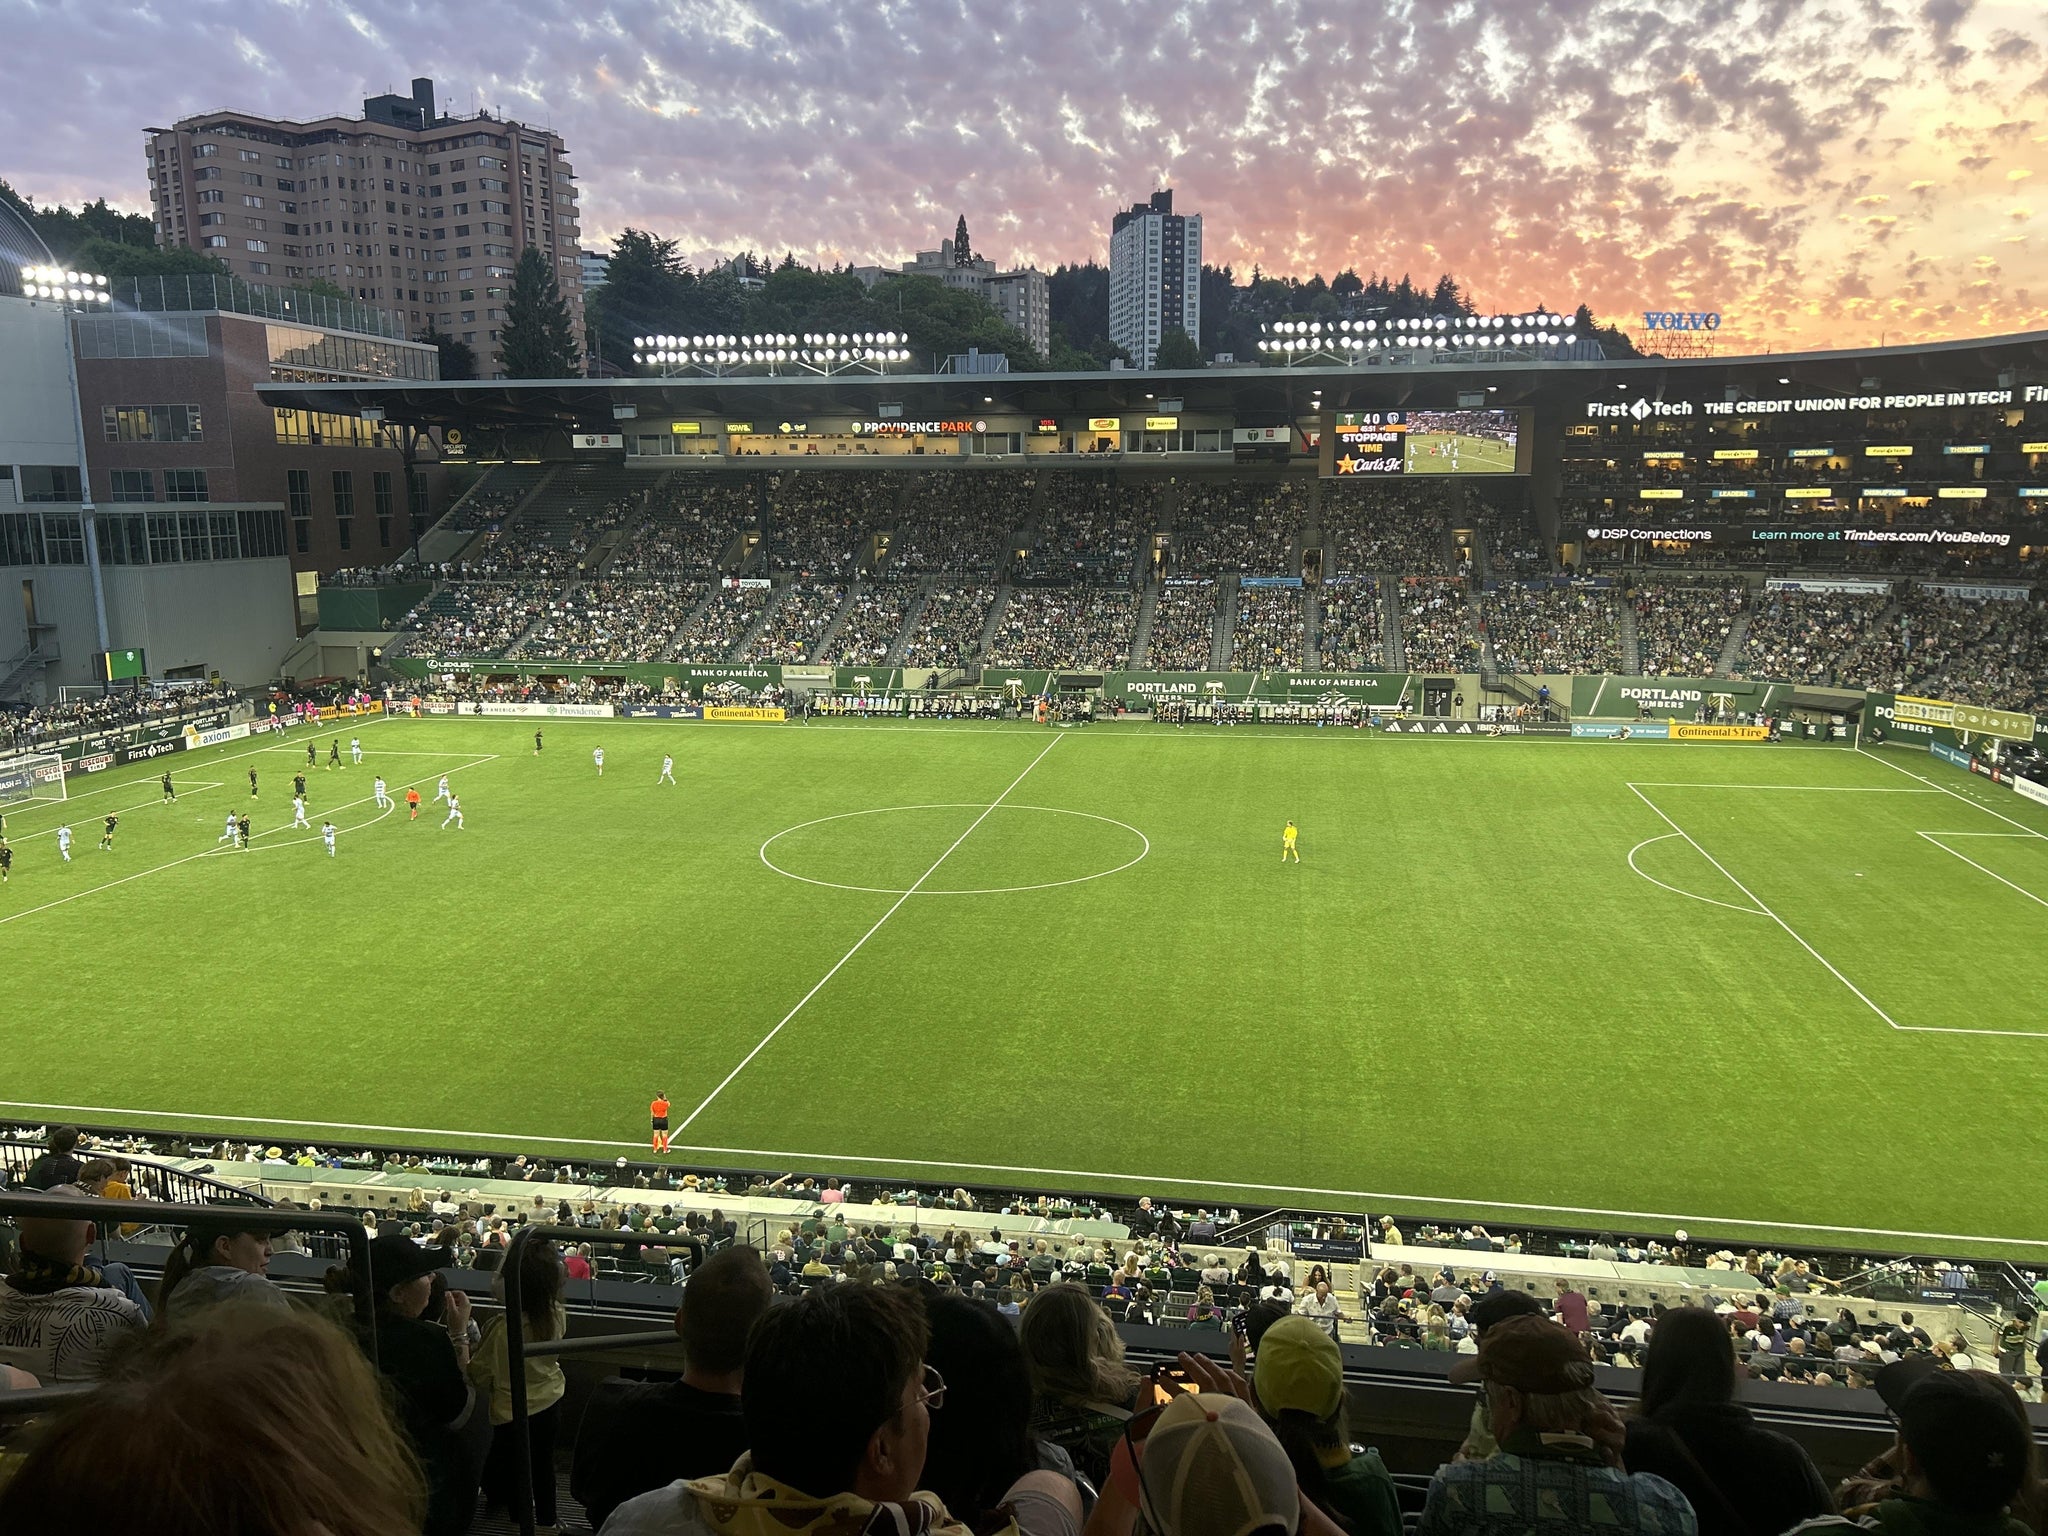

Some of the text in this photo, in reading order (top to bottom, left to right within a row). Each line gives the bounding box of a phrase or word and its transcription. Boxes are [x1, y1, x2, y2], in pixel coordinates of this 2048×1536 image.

[1643, 311, 1721, 331] VOLVO
[1704, 391, 2012, 415] THE CREDIT UNION FOR PEOPLE IN TECH
[1588, 401, 1693, 417] First Tech
[1363, 413, 1380, 424] 4 0
[864, 421, 973, 432] PROVIDENCE PARK
[1342, 433, 1398, 442] STOPPAGE
[1358, 443, 1383, 453] TIME
[1602, 529, 1711, 540] DSP Connections
[1752, 530, 2011, 546] Learn more at Timbers.com/YouBelong
[1127, 682, 1197, 693] PORTLAND
[1290, 678, 1378, 687] BANK OF AMERICA
[1142, 693, 1182, 701] TIMBERS
[1621, 687, 1702, 702] PORTLAND
[1638, 700, 1684, 709] TIMBERS
[560, 706, 602, 717] Providence
[711, 708, 779, 718] Continental Tire
[1678, 726, 1762, 738] Continental Tire
[1890, 720, 1934, 734] TIMBERS
[202, 729, 231, 744] axiom
[128, 742, 174, 760] First Tech
[80, 754, 113, 768] DISCOUNT
